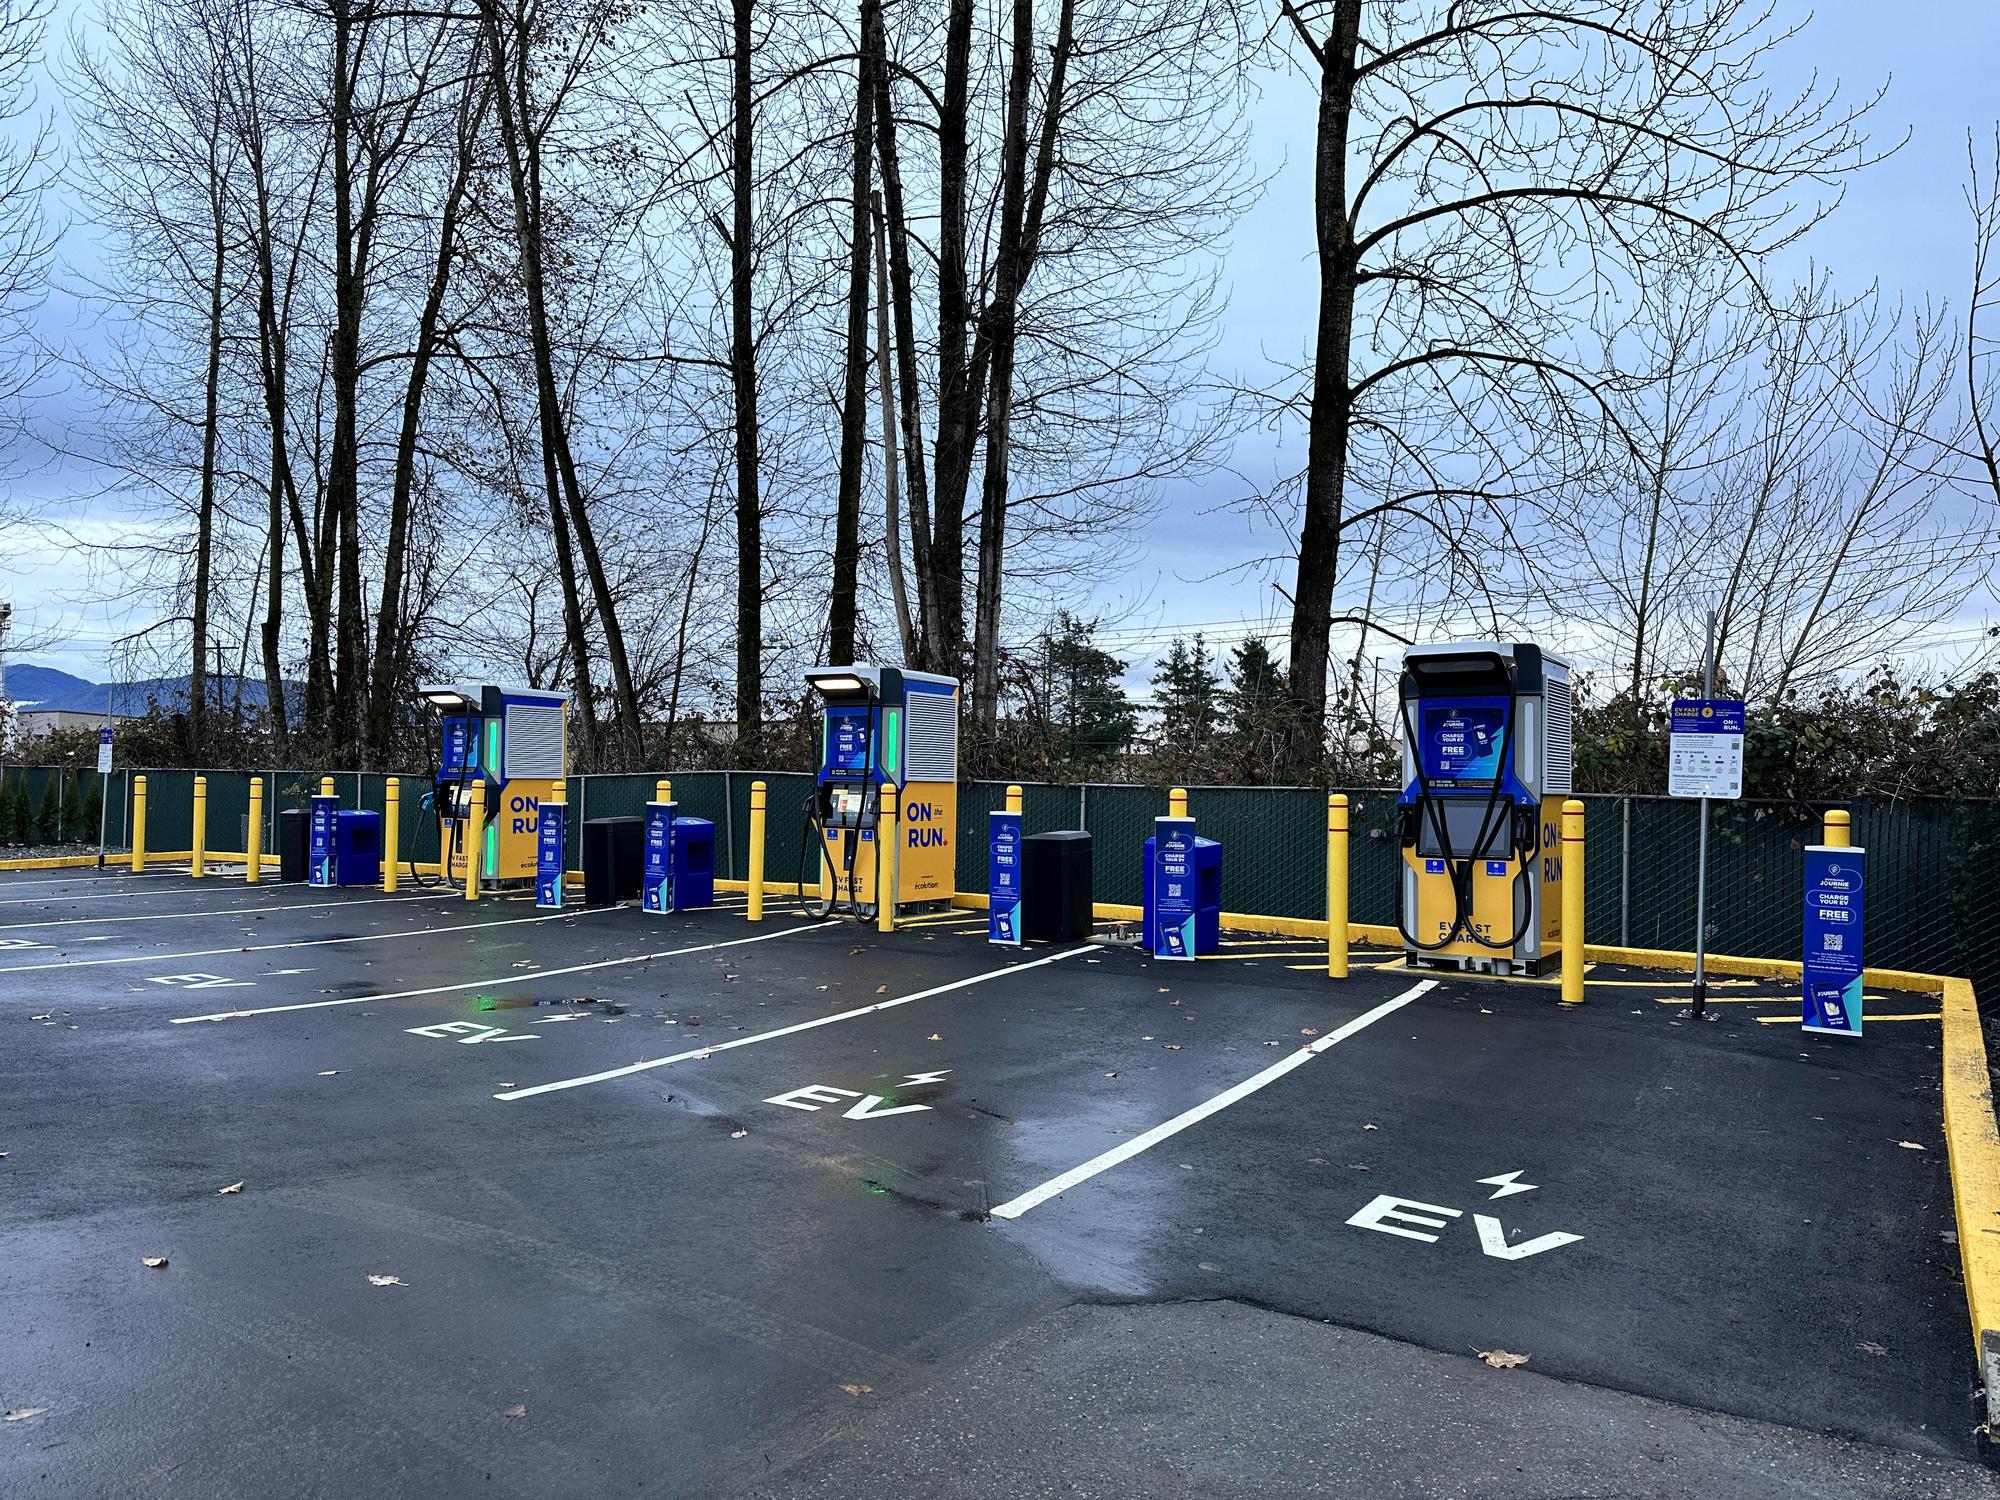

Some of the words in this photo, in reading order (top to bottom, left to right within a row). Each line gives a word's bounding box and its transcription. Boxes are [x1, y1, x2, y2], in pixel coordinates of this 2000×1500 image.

[510, 796, 538, 813] ON
[907, 803, 931, 821] ON
[934, 808, 943, 816] the
[512, 818, 538, 834] RU
[1544, 822, 1557, 849] ON
[845, 877, 863, 885] FST
[1819, 893, 1849, 901] CHARGE
[1819, 909, 1849, 919] FREE
[144, 973, 257, 989] EV
[403, 1020, 543, 1044] EV
[761, 1084, 933, 1120] EV
[1344, 1194, 1585, 1260] EV
